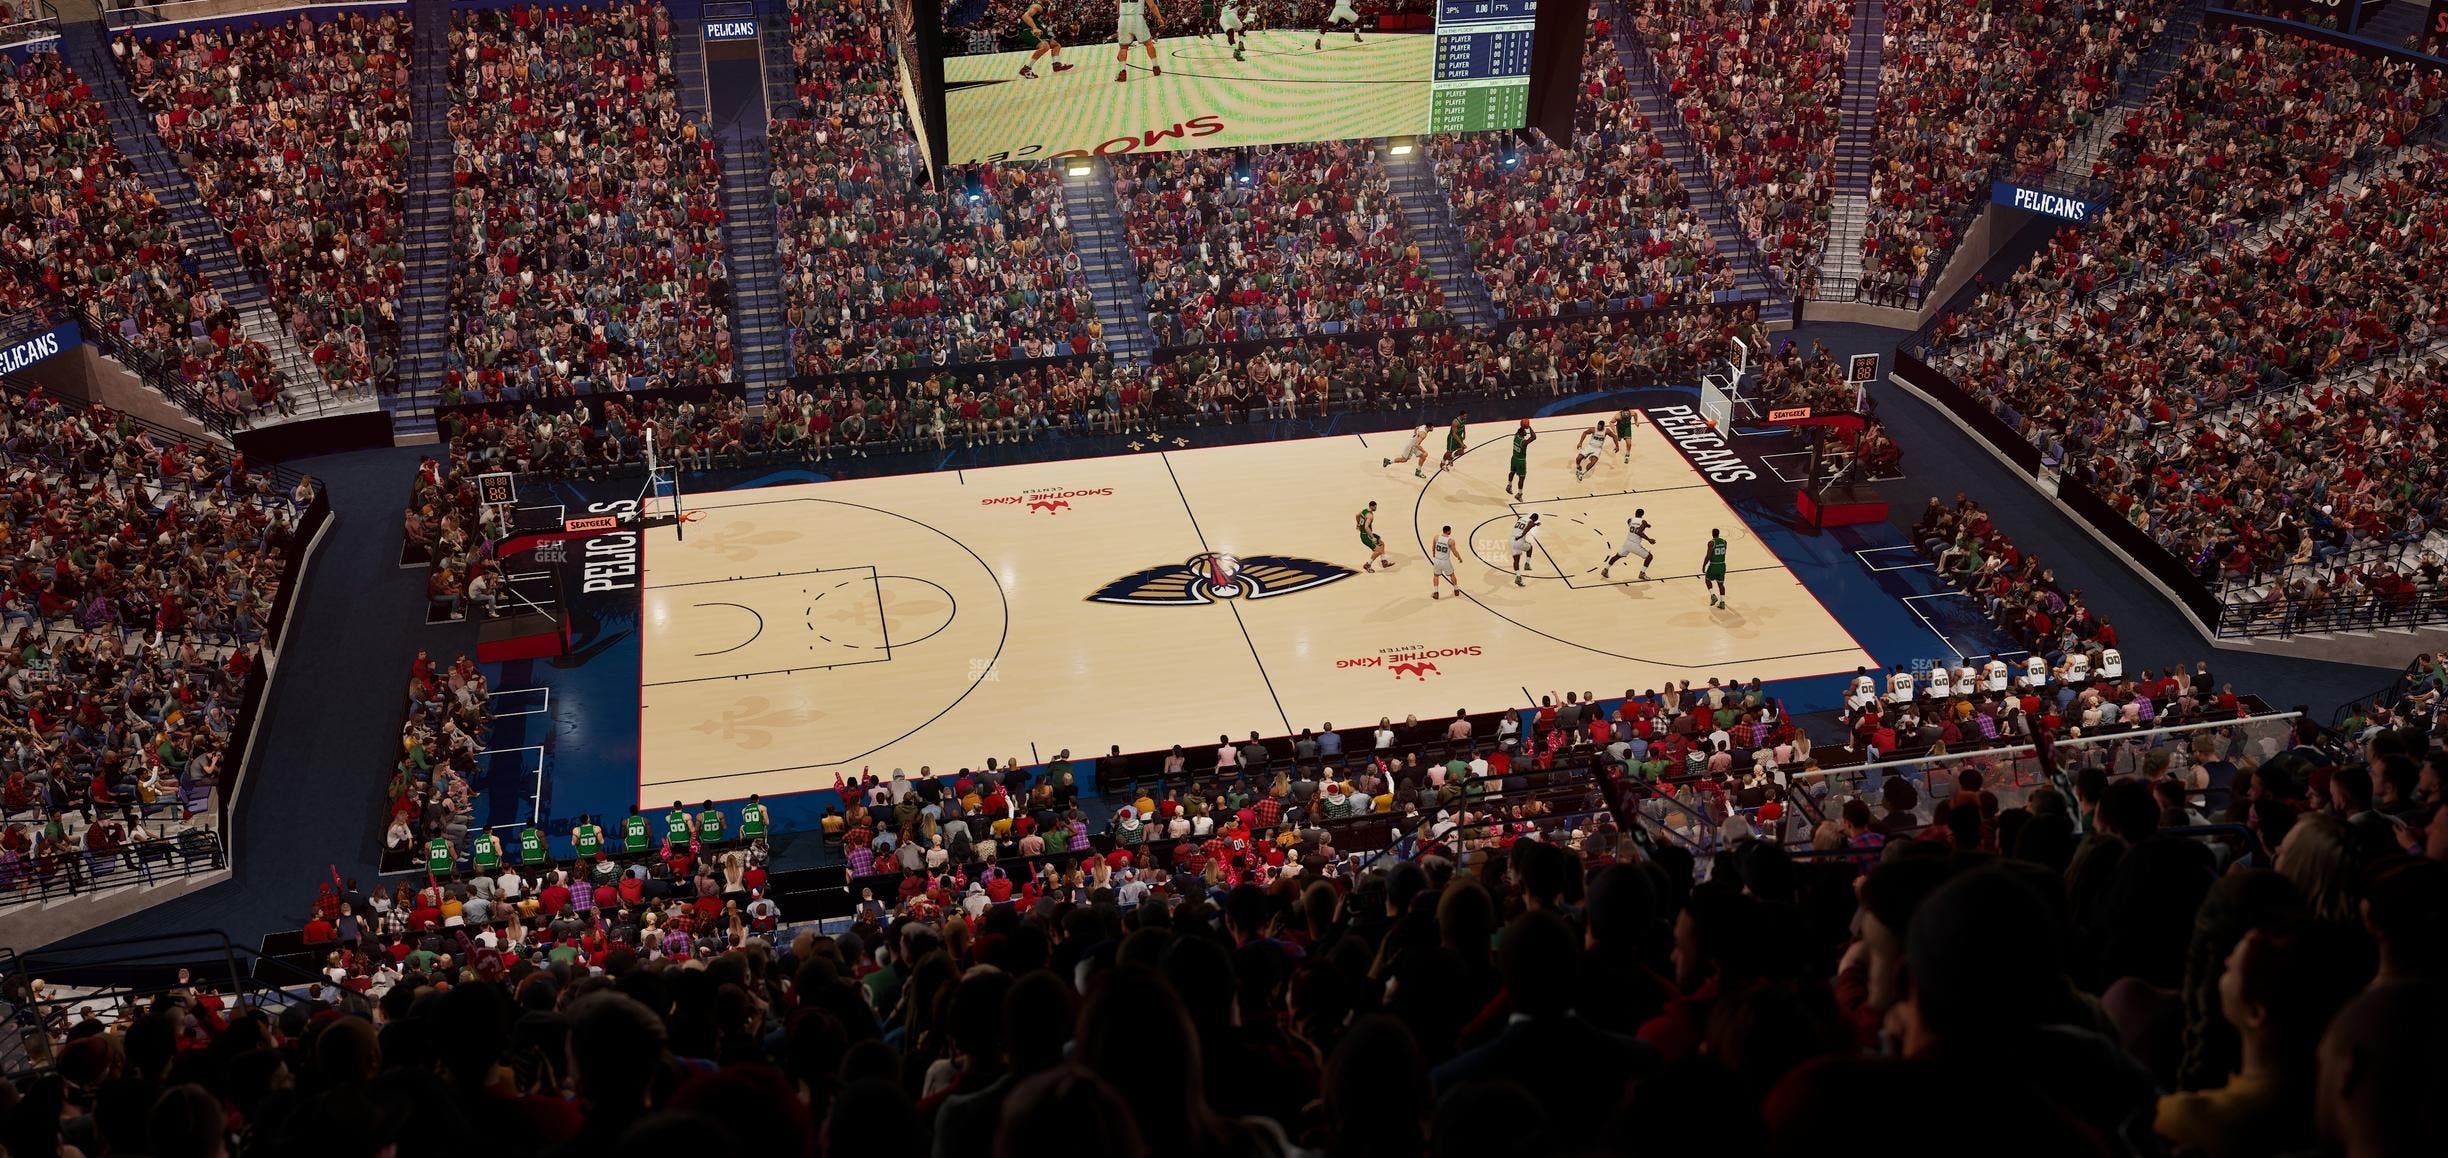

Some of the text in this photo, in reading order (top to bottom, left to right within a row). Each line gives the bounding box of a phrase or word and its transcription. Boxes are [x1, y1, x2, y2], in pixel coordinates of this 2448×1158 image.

[1495, 4, 1509, 12] FT%
[707, 22, 754, 37] PELICANS
[1451, 35, 1472, 43] PLAYER
[1450, 44, 1471, 52] PLAYER
[1445, 98, 1466, 106] PLAYER
[1444, 115, 1464, 123] PLAYER
[2014, 188, 2085, 221] PELICANS
[1773, 408, 1806, 419] SEATGEEK
[1647, 404, 1757, 483] PELICANS
[490, 487, 506, 500] 88
[1023, 486, 1063, 494] CENTER
[1029, 487, 1114, 501] SMOOTHIE
[570, 519, 612, 530] SEATGEEK
[1513, 522, 1526, 530] 00
[583, 499, 637, 594] PELICS
[1436, 545, 1449, 554] 00
[1714, 548, 1726, 556] 00
[1379, 644, 1425, 653] CENTER
[1388, 646, 1482, 663] SMOOTHIE
[2105, 656, 2120, 665] 00
[1994, 669, 2007, 678] 00
[2031, 667, 2045, 675] 00
[2074, 665, 2087, 673] 00
[1896, 680, 1911, 690] 00
[1934, 677, 1948, 686] 00
[1861, 685, 1875, 694] 00
[744, 811, 760, 822] 00
[629, 826, 644, 836] 00
[670, 822, 685, 832] 00
[704, 822, 719, 831] 00
[522, 840, 538, 849] 00
[580, 837, 596, 846] 00
[1233, 838, 1246, 851] 00
[475, 842, 490, 853] 00
[431, 849, 447, 859] 00
